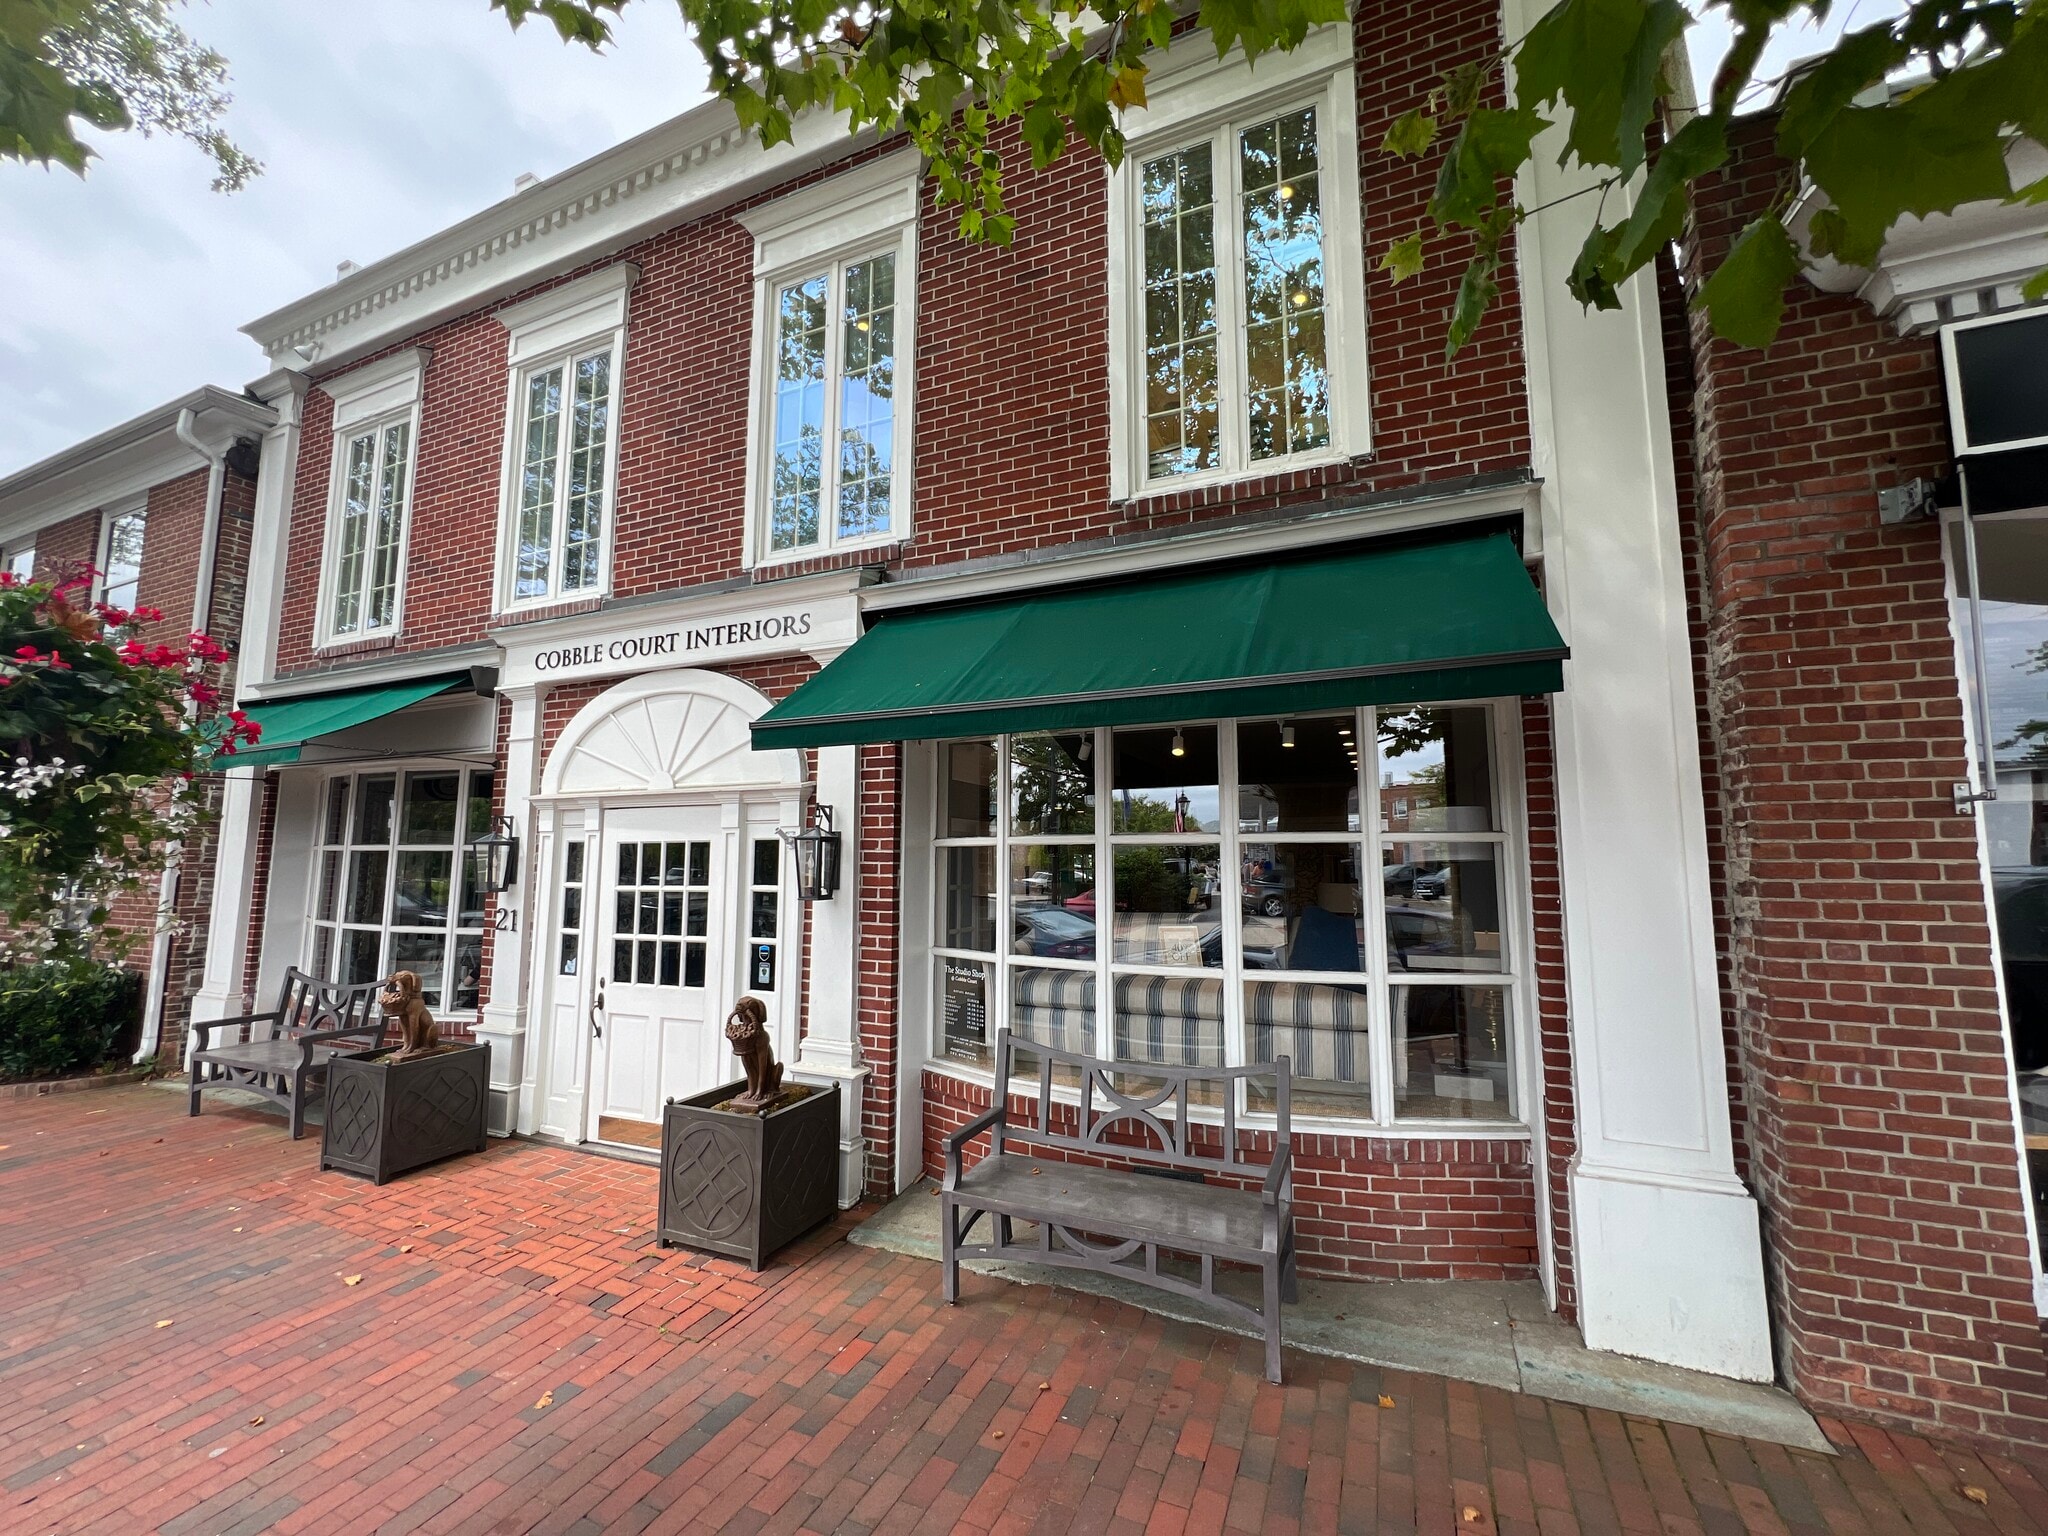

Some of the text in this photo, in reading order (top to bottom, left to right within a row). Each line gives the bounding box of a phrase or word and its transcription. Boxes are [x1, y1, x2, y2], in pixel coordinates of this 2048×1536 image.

[535, 613, 812, 671] COBBLE COURT INTERIORS
[496, 908, 517, 931] 21
[944, 965, 986, 981] The Studio Shop
